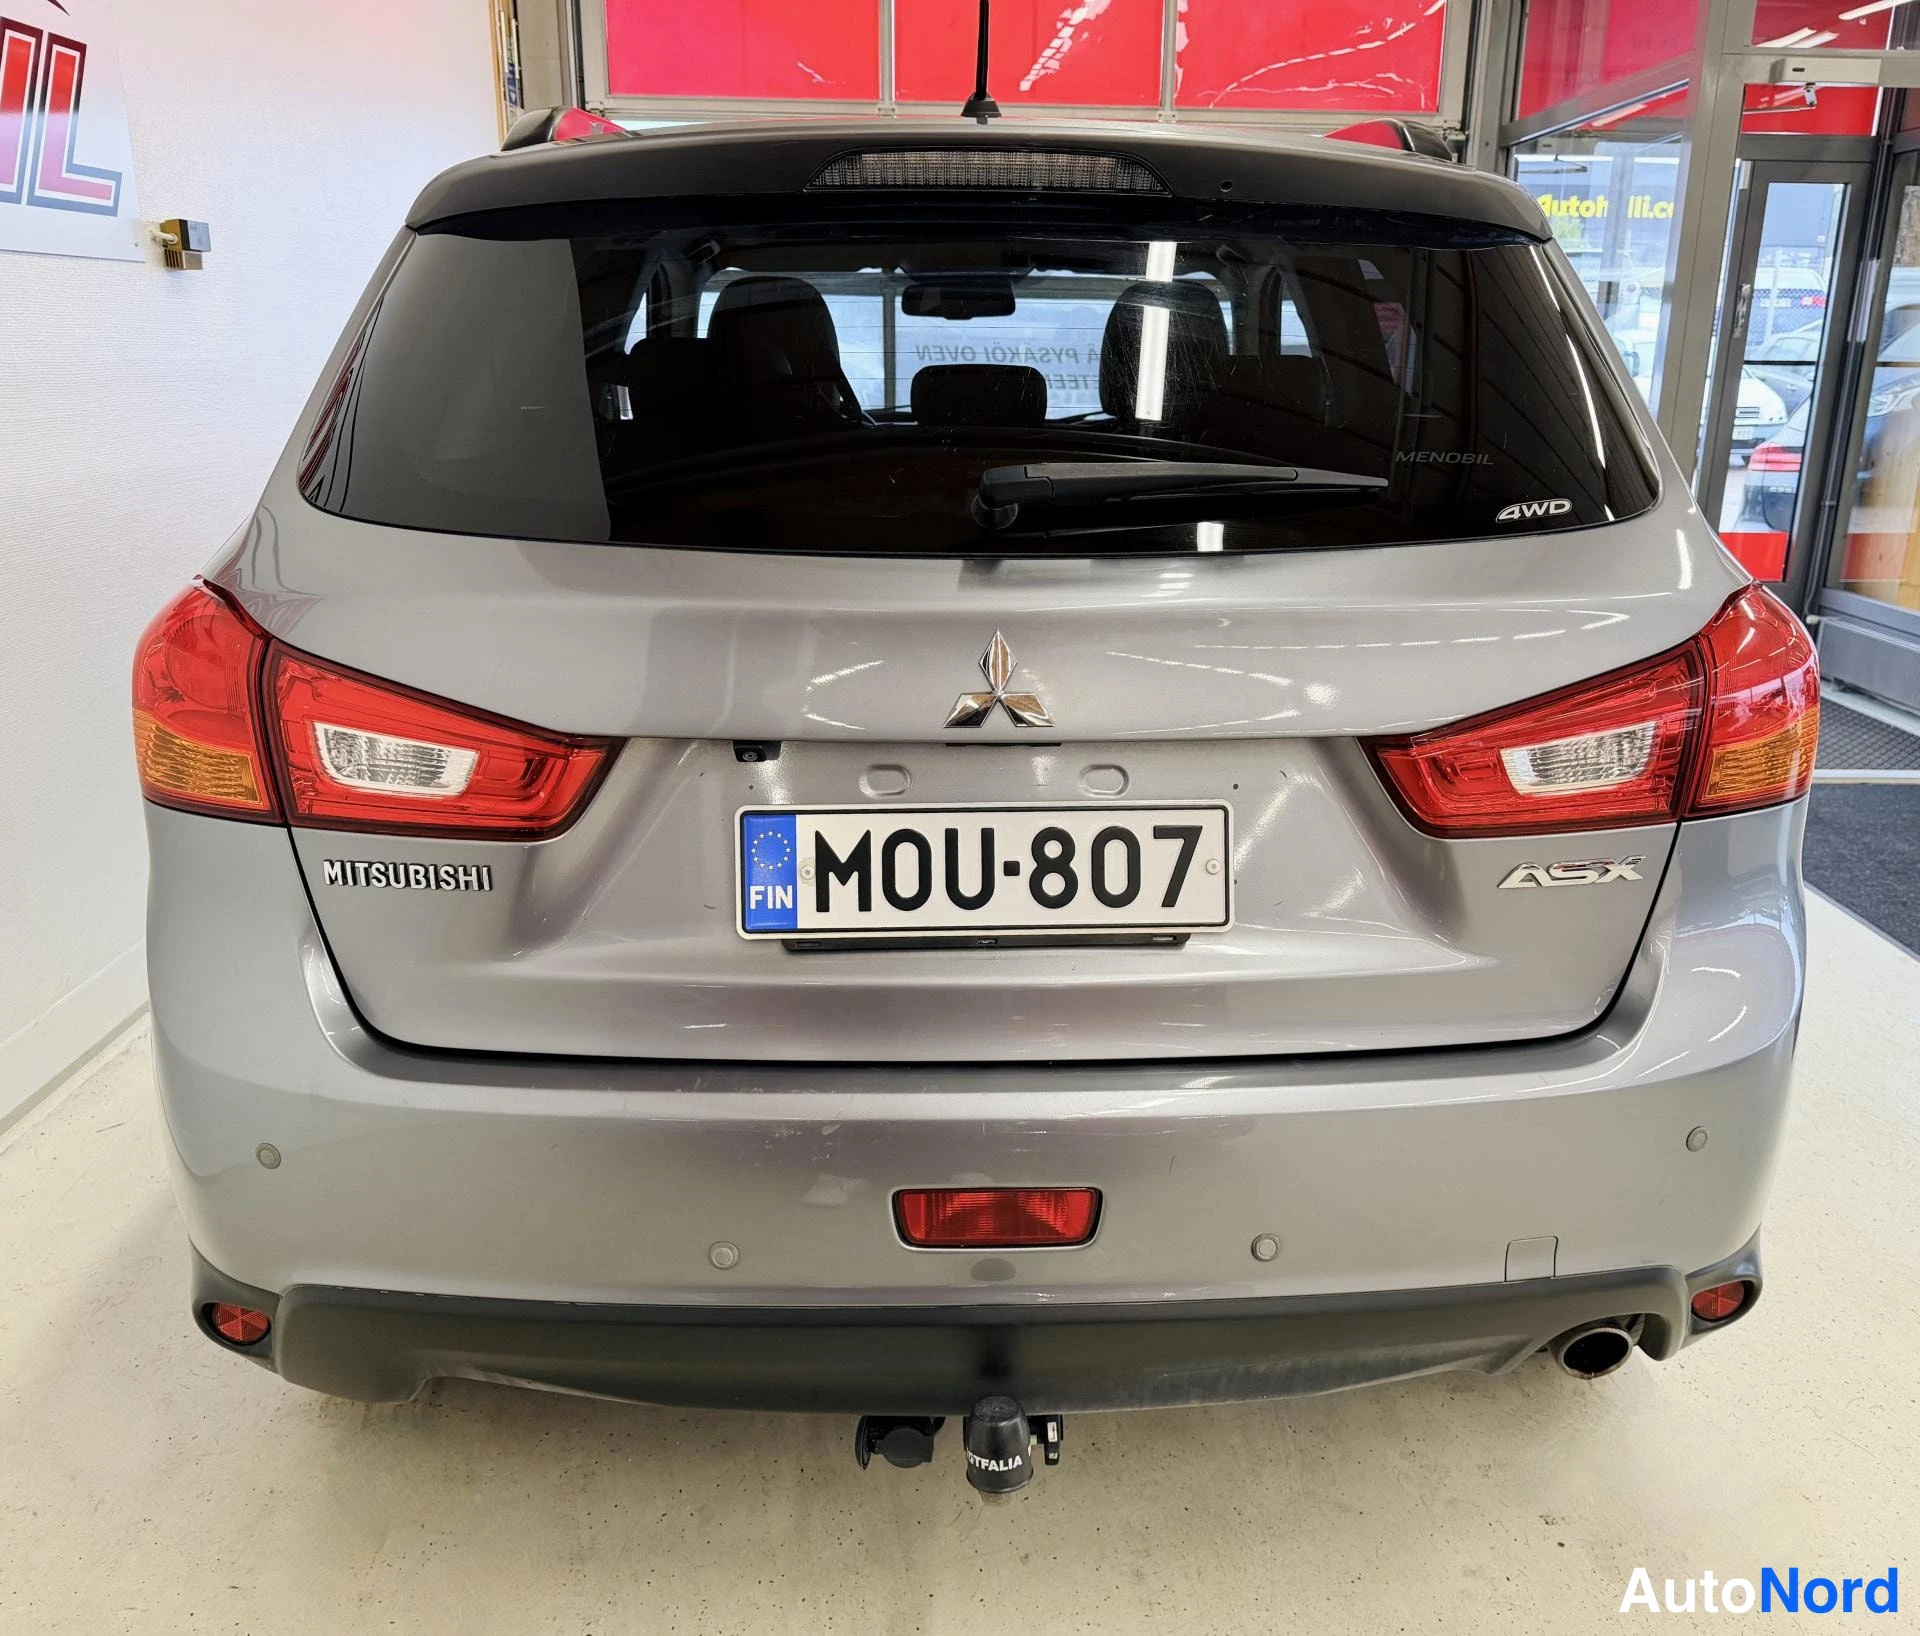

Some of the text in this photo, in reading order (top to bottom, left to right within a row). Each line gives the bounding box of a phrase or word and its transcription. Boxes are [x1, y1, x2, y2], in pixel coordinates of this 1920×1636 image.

[1395, 451, 1495, 465] MENOBIL
[1498, 499, 1572, 521] 4WD
[323, 859, 492, 891] MITSUBISHI
[815, 825, 1203, 912] MOU-807
[1497, 855, 1646, 889] ASX
[750, 884, 793, 909] FIN
